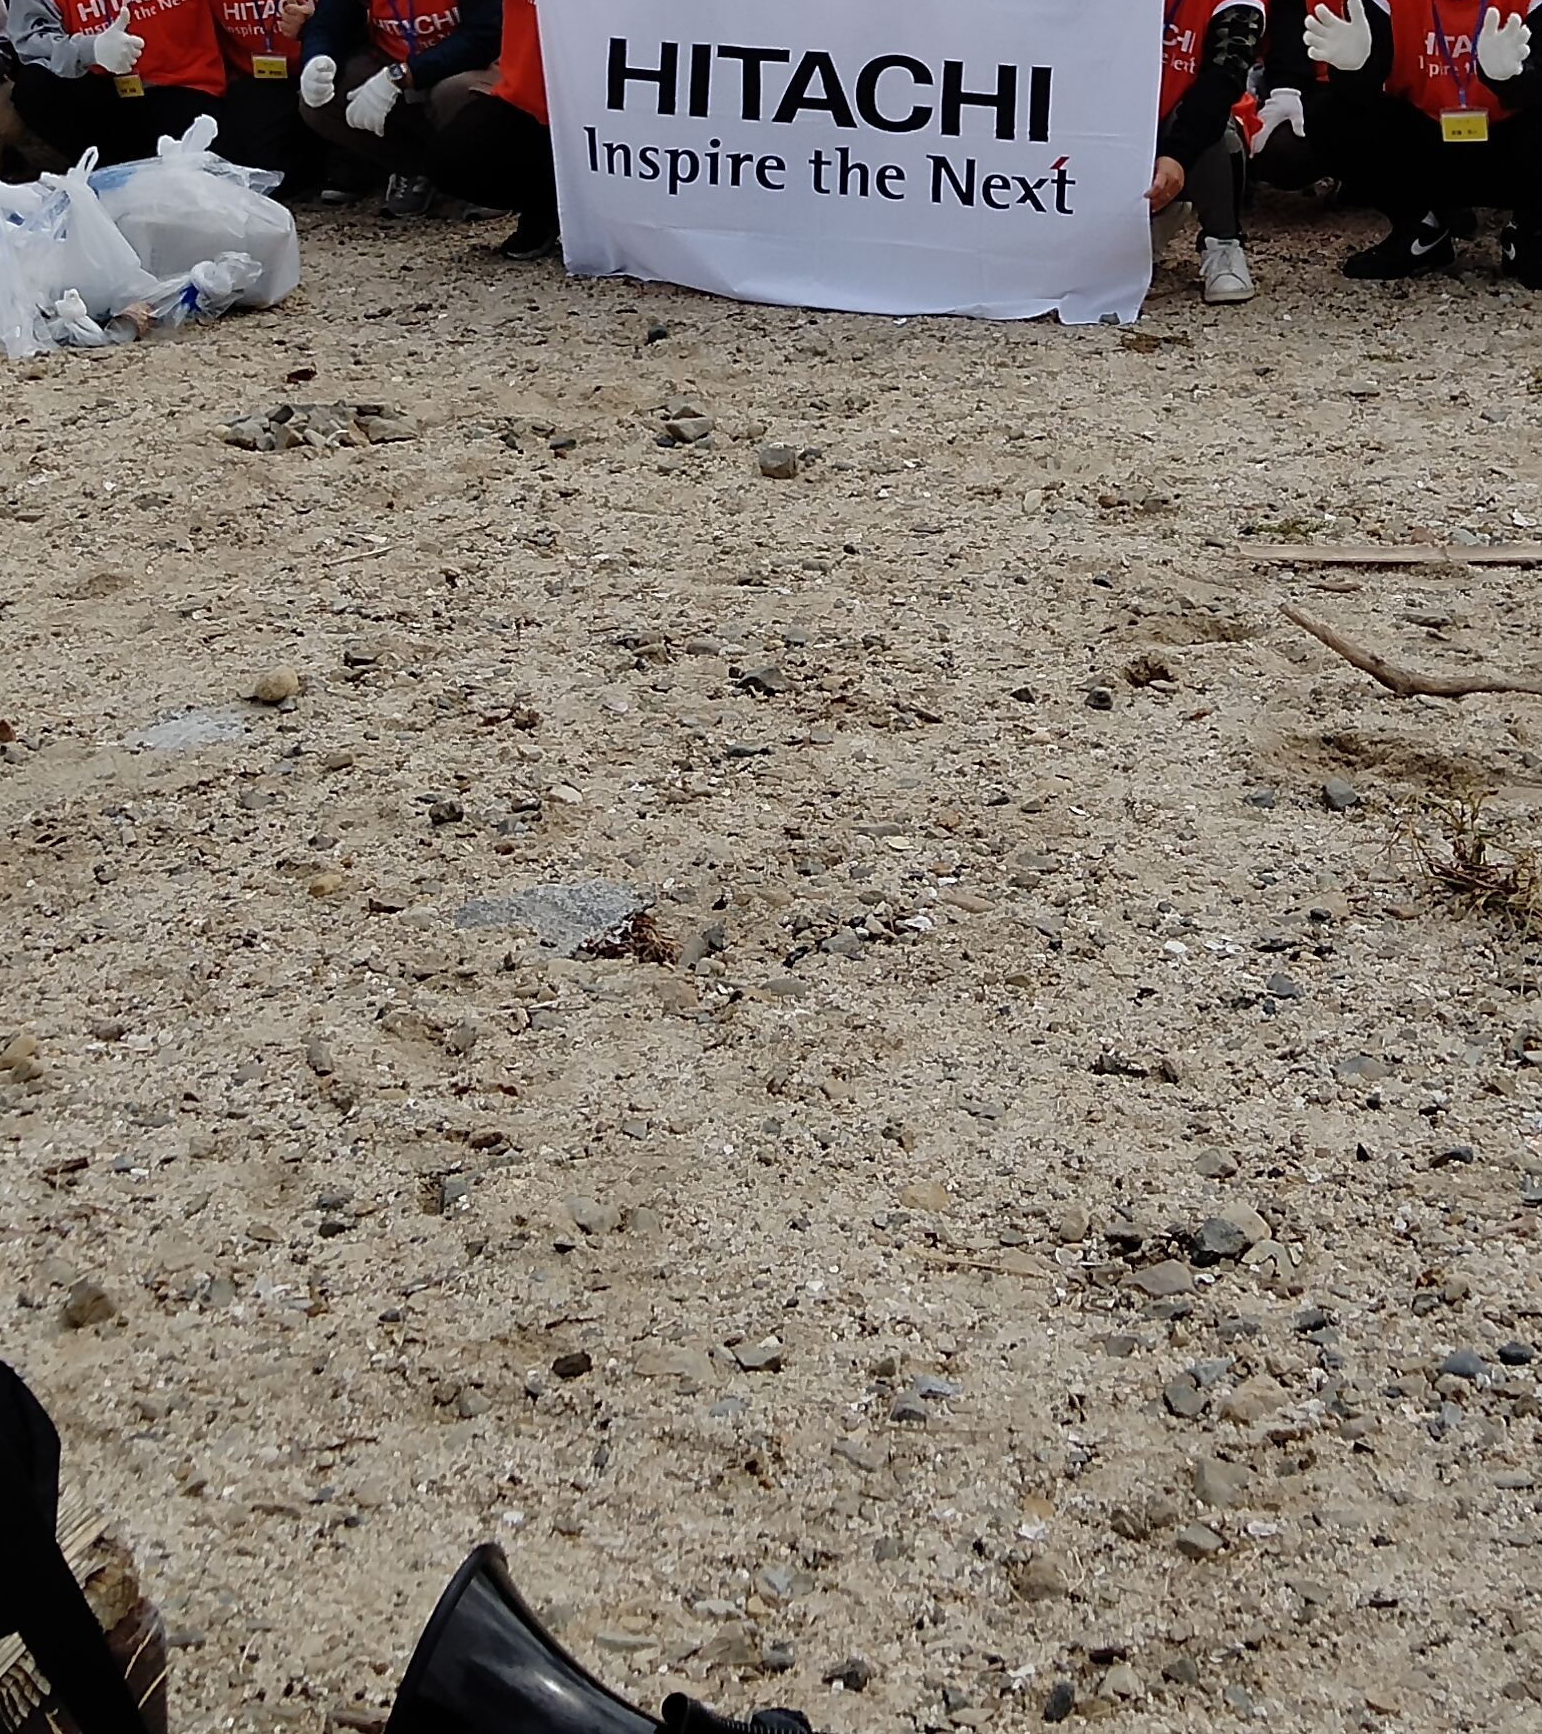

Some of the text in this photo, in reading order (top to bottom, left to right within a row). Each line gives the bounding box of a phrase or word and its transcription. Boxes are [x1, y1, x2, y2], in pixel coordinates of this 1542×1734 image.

[133, 4, 158, 22] the
[606, 36, 1053, 142] HITACHI
[583, 126, 1077, 215] Inspire the Next
